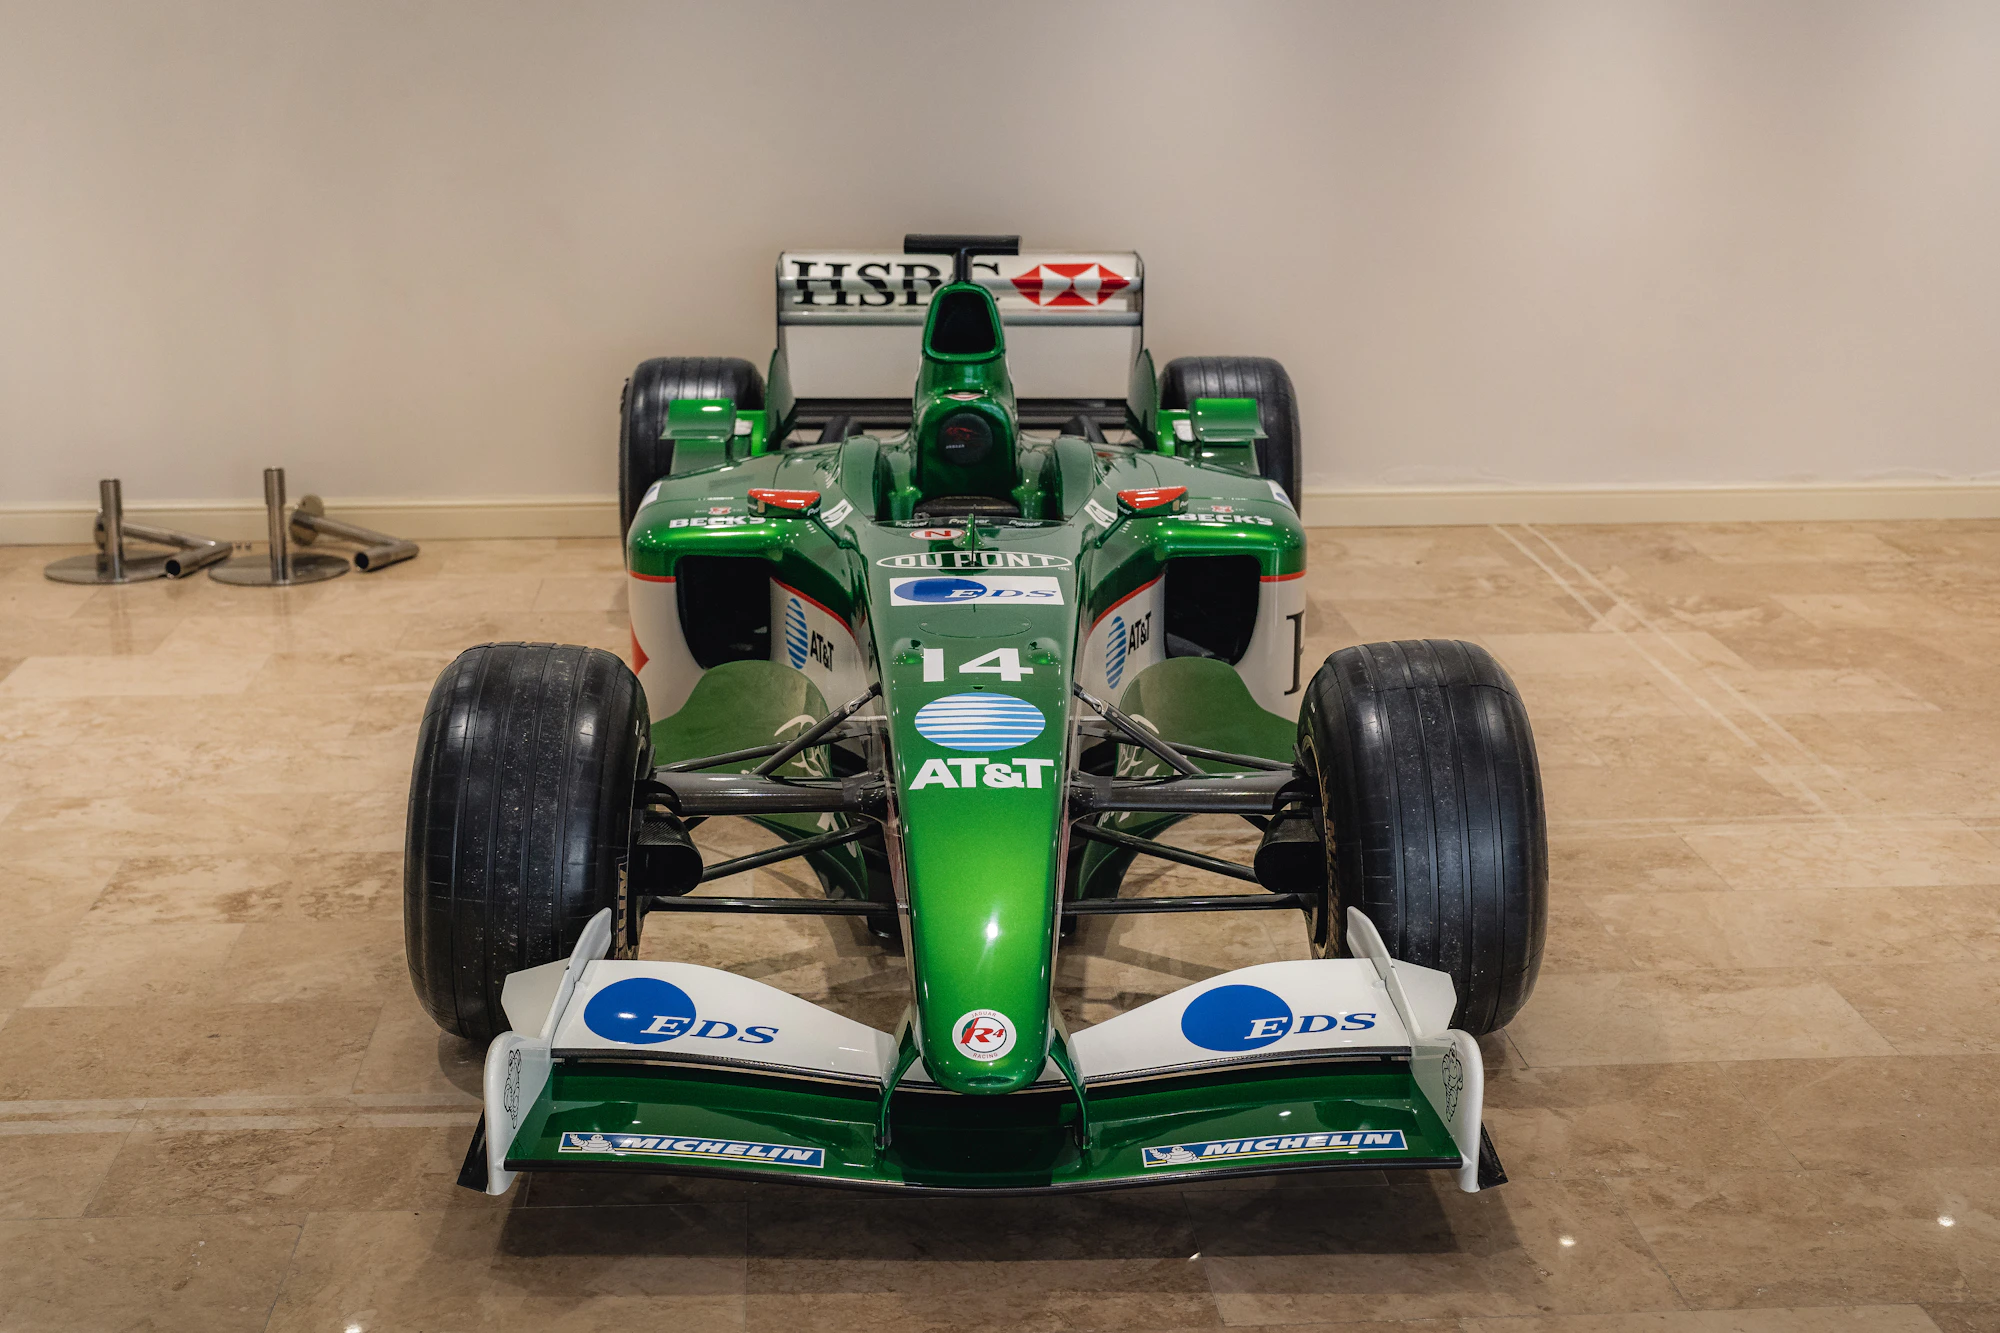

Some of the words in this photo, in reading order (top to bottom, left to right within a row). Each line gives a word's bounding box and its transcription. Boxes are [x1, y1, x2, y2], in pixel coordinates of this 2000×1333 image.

[895, 520, 929, 528] Pioneer
[1008, 519, 1043, 527] Pioneer
[944, 588, 1057, 599] EDS
[1128, 610, 1152, 655] AT&T
[810, 630, 835, 672] AT&T
[922, 647, 1034, 682] 14
[908, 757, 1055, 790] AT&T
[640, 1014, 780, 1044] EDS
[960, 1017, 1005, 1044] R4
[1244, 1012, 1377, 1040] EDS
[618, 1135, 815, 1162] MICHELIN
[1202, 1131, 1394, 1157] MICHELIN
